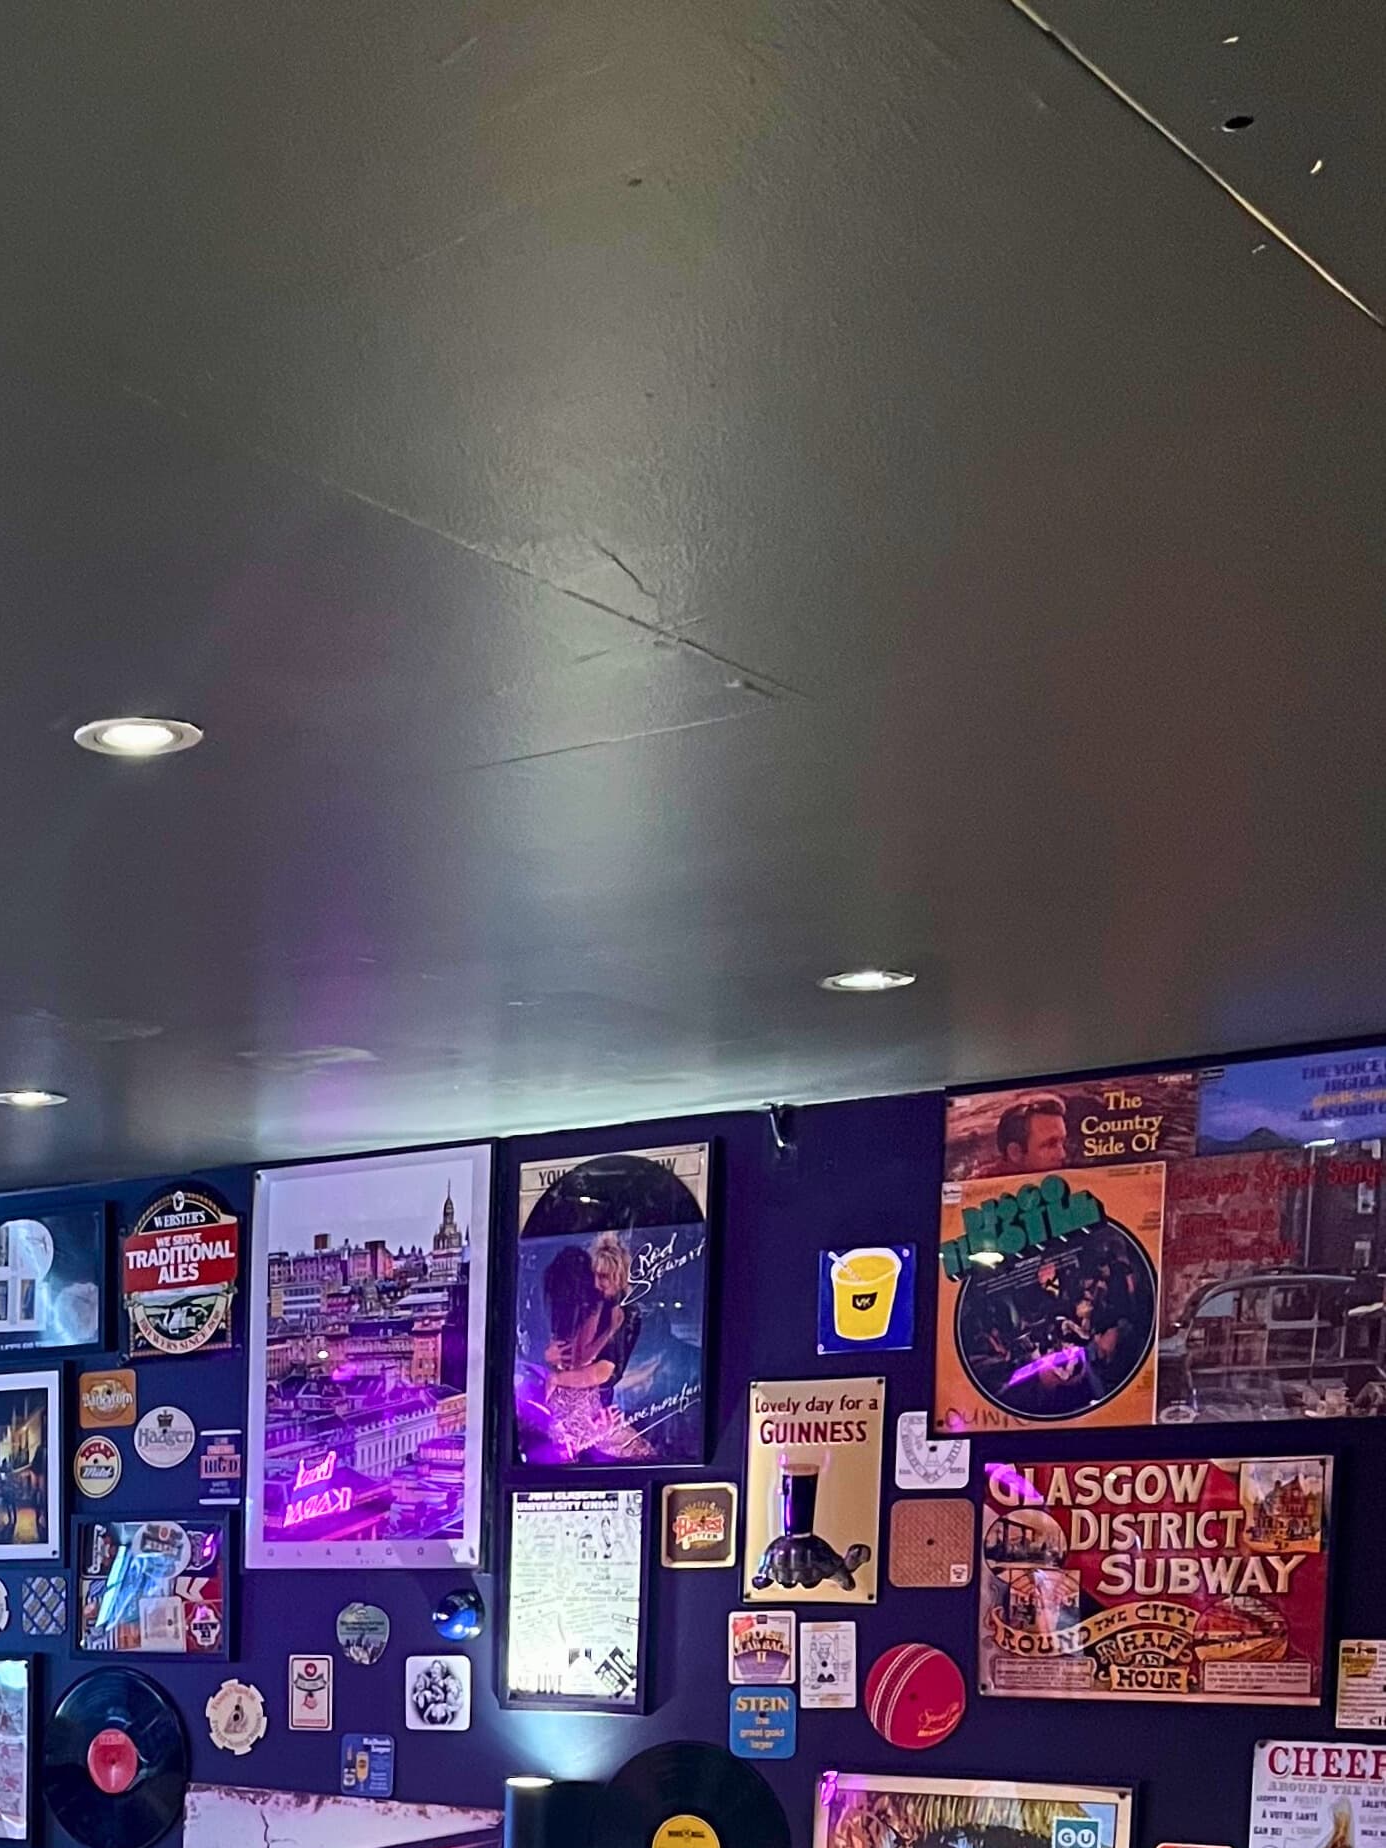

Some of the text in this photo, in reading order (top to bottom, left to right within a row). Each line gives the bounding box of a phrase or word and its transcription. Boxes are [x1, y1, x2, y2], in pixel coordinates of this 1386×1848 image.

[1103, 1091, 1142, 1111] The
[1081, 1115, 1163, 1135] Country
[1083, 1131, 1160, 1157] Side Of
[153, 1210, 206, 1228] WEBSTER'S
[156, 1232, 202, 1248] WE SERVE
[126, 1240, 236, 1270] TRADITIONAL
[157, 1263, 200, 1285] ALES
[854, 1297, 872, 1308] VK
[805, 1397, 833, 1416] day
[840, 1395, 864, 1411] for
[869, 1398, 878, 1411] a
[138, 1427, 193, 1448] Haagen
[760, 1420, 868, 1445] GUINNESS
[988, 1463, 1209, 1507] GLASGOW
[516, 1500, 618, 1511] UNIVERSITY UNION
[1070, 1509, 1245, 1552] DISTRICT
[1096, 1553, 1308, 1596] SUBWAY
[1002, 1603, 1196, 1654] ROUND THE CITY
[1120, 1632, 1183, 1655] HALF
[1139, 1654, 1163, 1666] AN
[1118, 1669, 1181, 1689] HOUR
[736, 1695, 789, 1712] STEIN
[1268, 1782, 1362, 1796] AROUND THE
